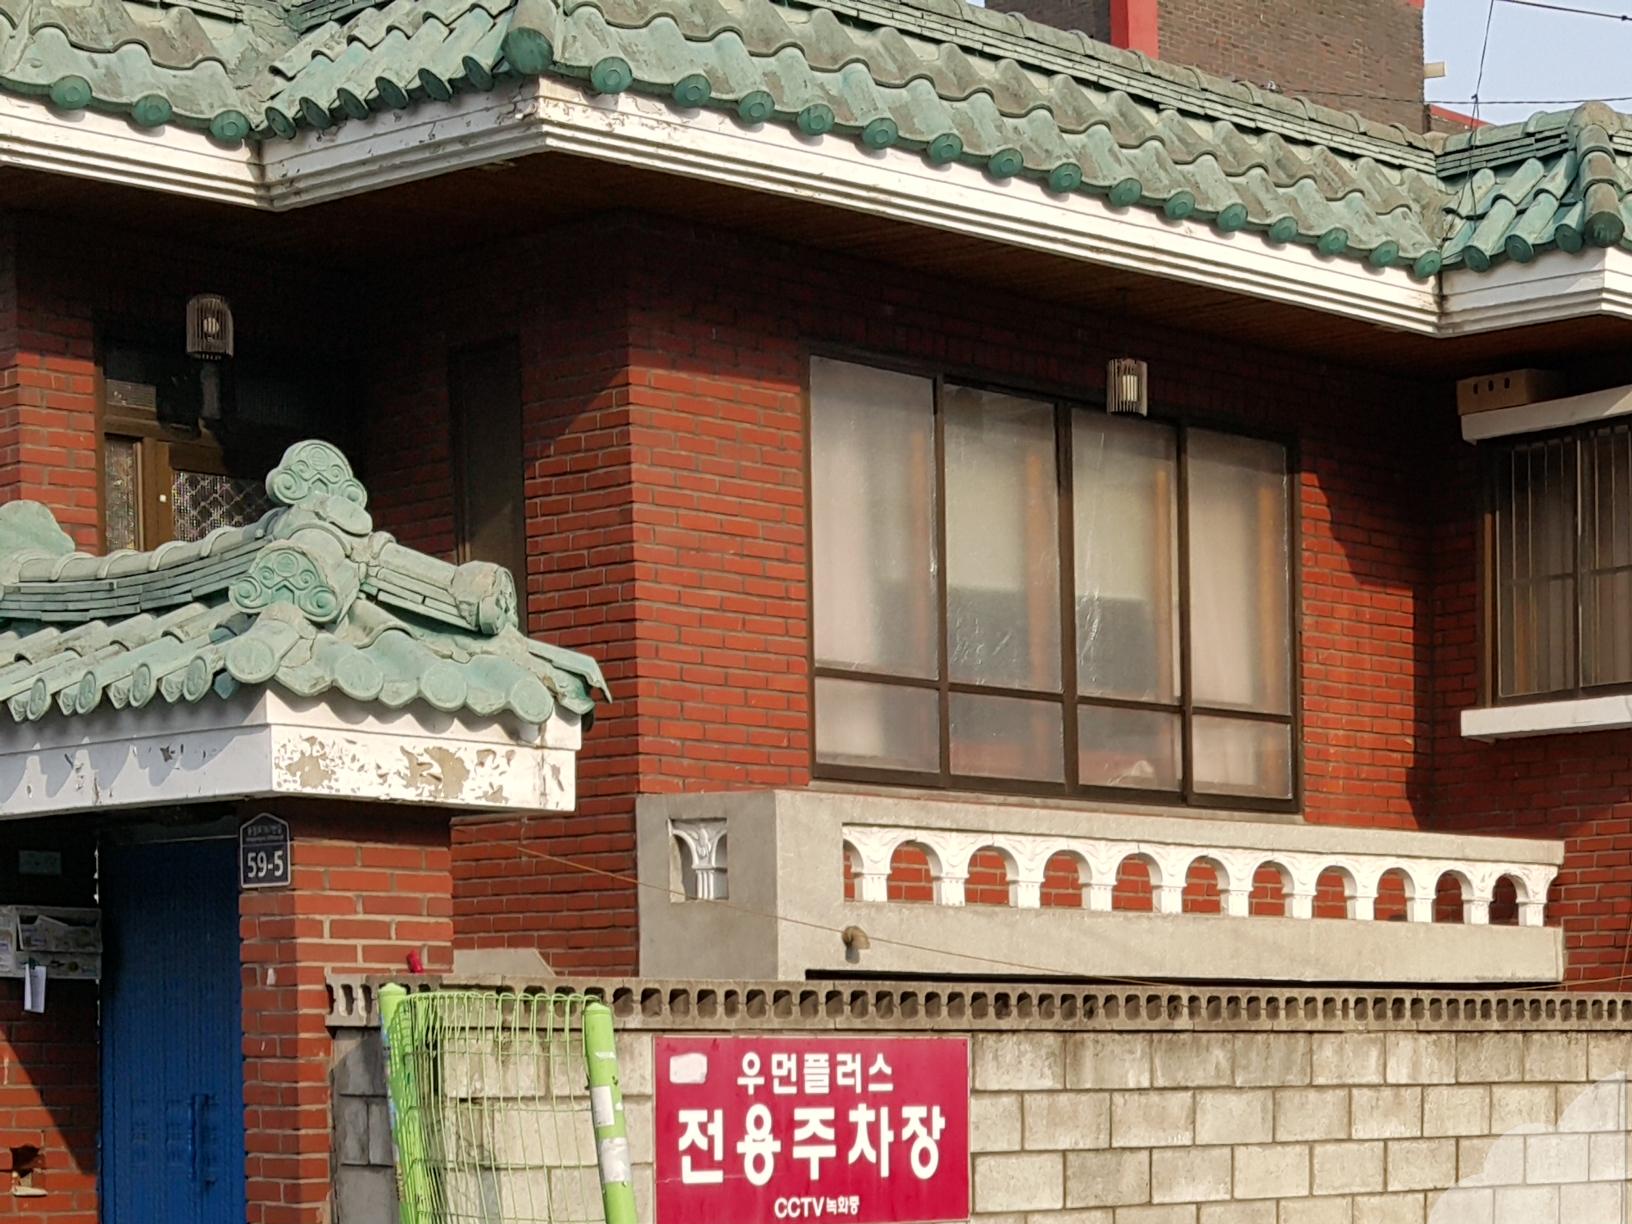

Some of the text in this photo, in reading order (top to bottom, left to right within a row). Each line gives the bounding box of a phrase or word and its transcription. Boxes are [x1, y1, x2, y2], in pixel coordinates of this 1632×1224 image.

[247, 850, 284, 878] 59-5
[737, 1051, 893, 1095] 우먼플러스
[678, 1103, 946, 1187] 전용주차장
